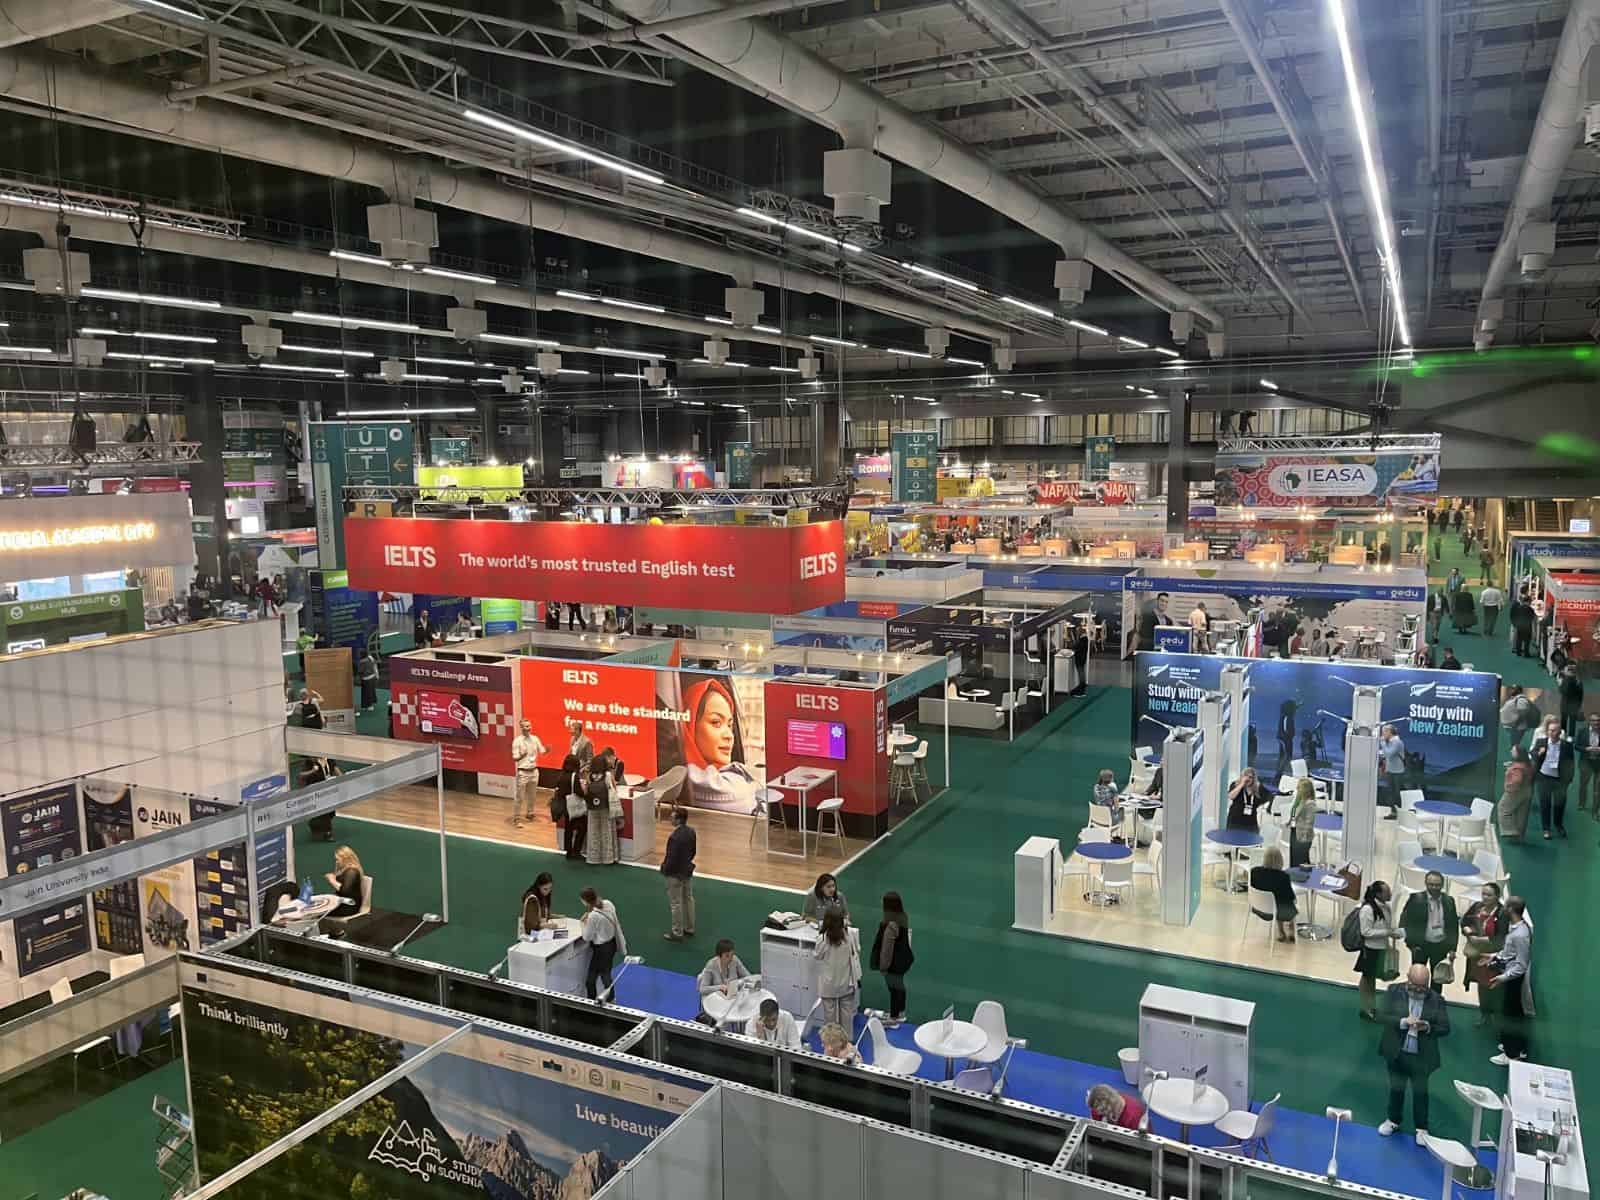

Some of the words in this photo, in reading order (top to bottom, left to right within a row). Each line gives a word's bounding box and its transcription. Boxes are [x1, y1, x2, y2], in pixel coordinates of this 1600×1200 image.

[359, 430, 372, 445] U
[360, 455, 373, 469] T
[1307, 468, 1365, 482] IEASA
[1042, 484, 1079, 498] JAPAN
[1107, 484, 1135, 498] JAPAN
[364, 503, 376, 516] R
[384, 544, 436, 568] IELTS
[459, 553, 484, 567] The
[487, 554, 538, 569] world's
[542, 557, 578, 571] most
[582, 558, 637, 573] trusted
[641, 560, 697, 579] English
[702, 563, 735, 577] test
[800, 551, 837, 580] IELTS
[1130, 580, 1153, 588] gedu
[1390, 589, 1419, 598] gedu
[1160, 637, 1184, 646] gedu
[432, 670, 466, 681] Challenge
[467, 673, 488, 682] Arena
[563, 669, 598, 685] IELTS
[1148, 683, 1177, 699] Study
[1178, 686, 1201, 699] with
[796, 693, 840, 711] IELTS
[1149, 697, 1170, 711] New
[1171, 699, 1197, 714] Zeala
[564, 699, 583, 711] We
[586, 702, 606, 713] are
[609, 702, 630, 715] the
[633, 706, 691, 722] standard
[1409, 703, 1444, 721] Study
[1446, 706, 1473, 721] with
[586, 721, 593, 730] a
[596, 721, 638, 735] reason
[876, 699, 885, 753] IELTS
[1409, 720, 1434, 734] New
[1437, 721, 1484, 738] Zealand
[34, 804, 60, 819] JAIN
[151, 809, 182, 825] JAIN
[25, 885, 44, 899] Jain
[45, 871, 89, 892] University
[198, 1002, 233, 1023] Think
[234, 1011, 289, 1040] brilliantly
[576, 1103, 607, 1125] Live
[426, 1162, 437, 1174] IN
[438, 1166, 485, 1190] SLOVENIA
[452, 1160, 482, 1177] STUDY
